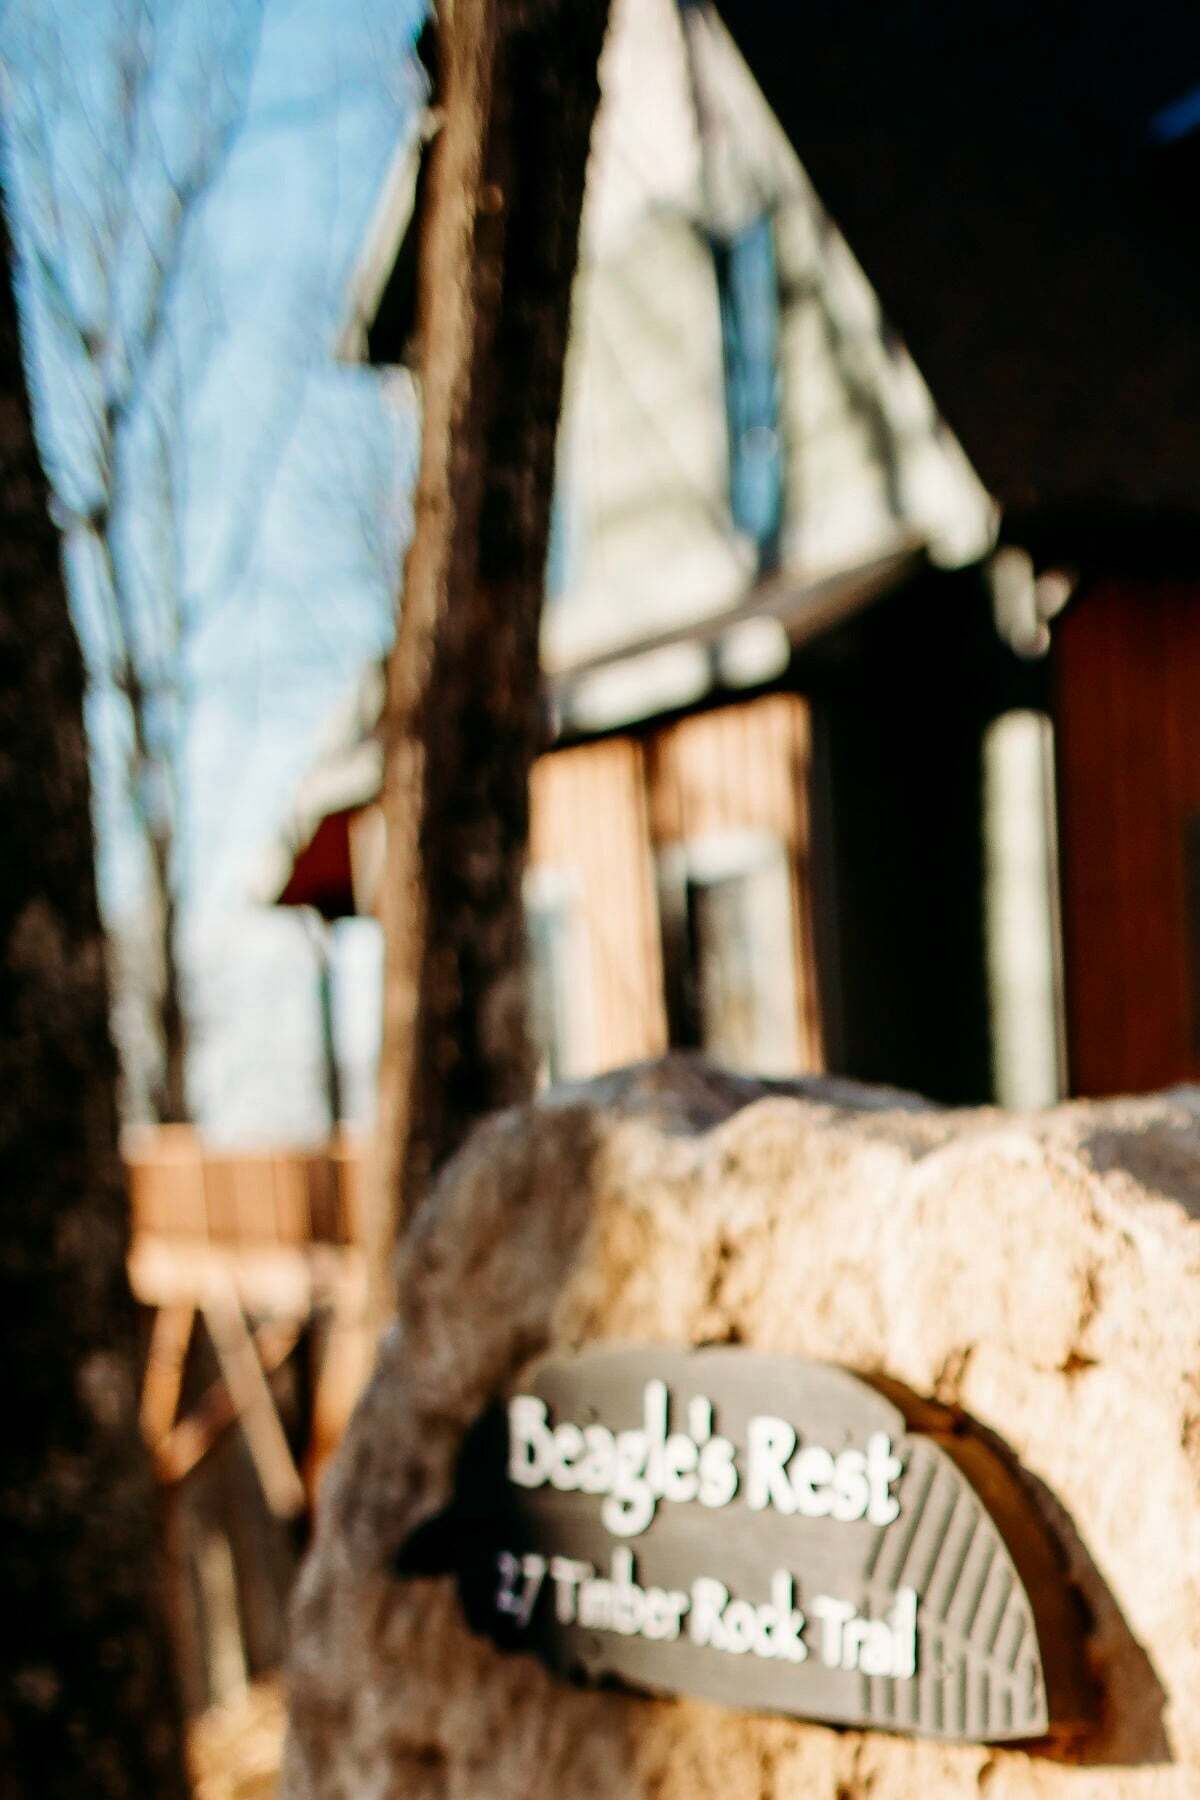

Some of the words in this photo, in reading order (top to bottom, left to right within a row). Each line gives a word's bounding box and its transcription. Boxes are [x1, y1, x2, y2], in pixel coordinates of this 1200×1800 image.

[508, 1378, 739, 1537] Beagle's
[745, 1416, 903, 1527] Rest
[550, 1545, 689, 1641] Timber
[691, 1568, 808, 1663] Rock
[812, 1586, 917, 1679] Trail
